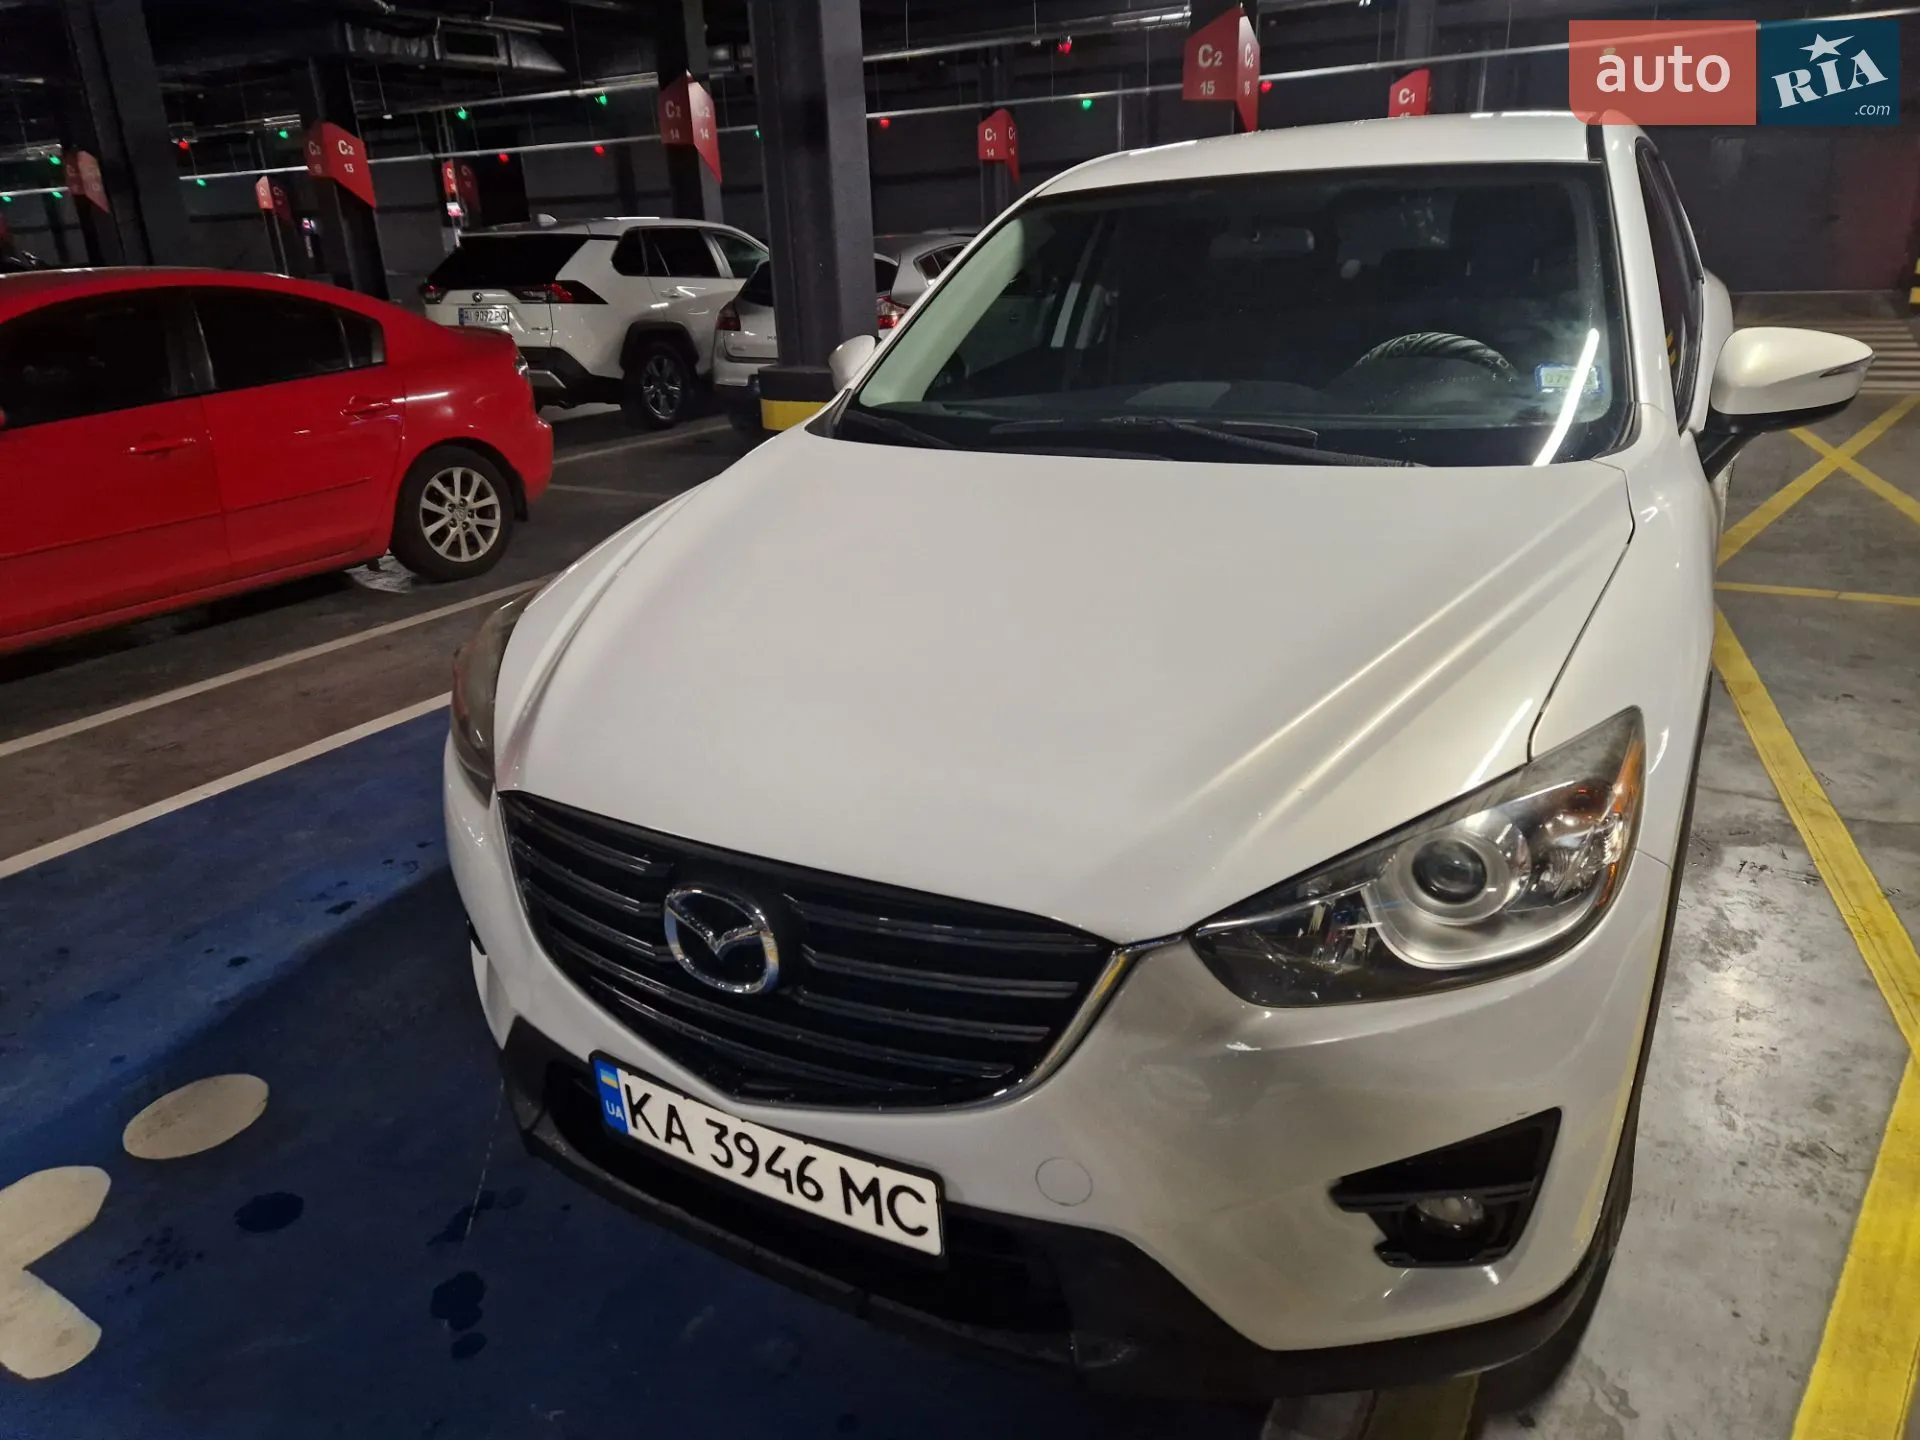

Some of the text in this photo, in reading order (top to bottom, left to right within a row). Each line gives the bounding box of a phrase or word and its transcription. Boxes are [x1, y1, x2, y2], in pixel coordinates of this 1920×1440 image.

[1198, 44, 1223, 67] C2
[1200, 80, 1216, 96] 15
[1398, 87, 1416, 105] C1
[665, 101, 681, 118] C2
[670, 128, 680, 140] 14
[700, 127, 710, 139] 14
[984, 127, 997, 141] C1
[338, 139, 355, 155] C2
[343, 163, 354, 173] 13
[605, 1100, 625, 1121] UA
[624, 1083, 929, 1237] KA 3946 MC
